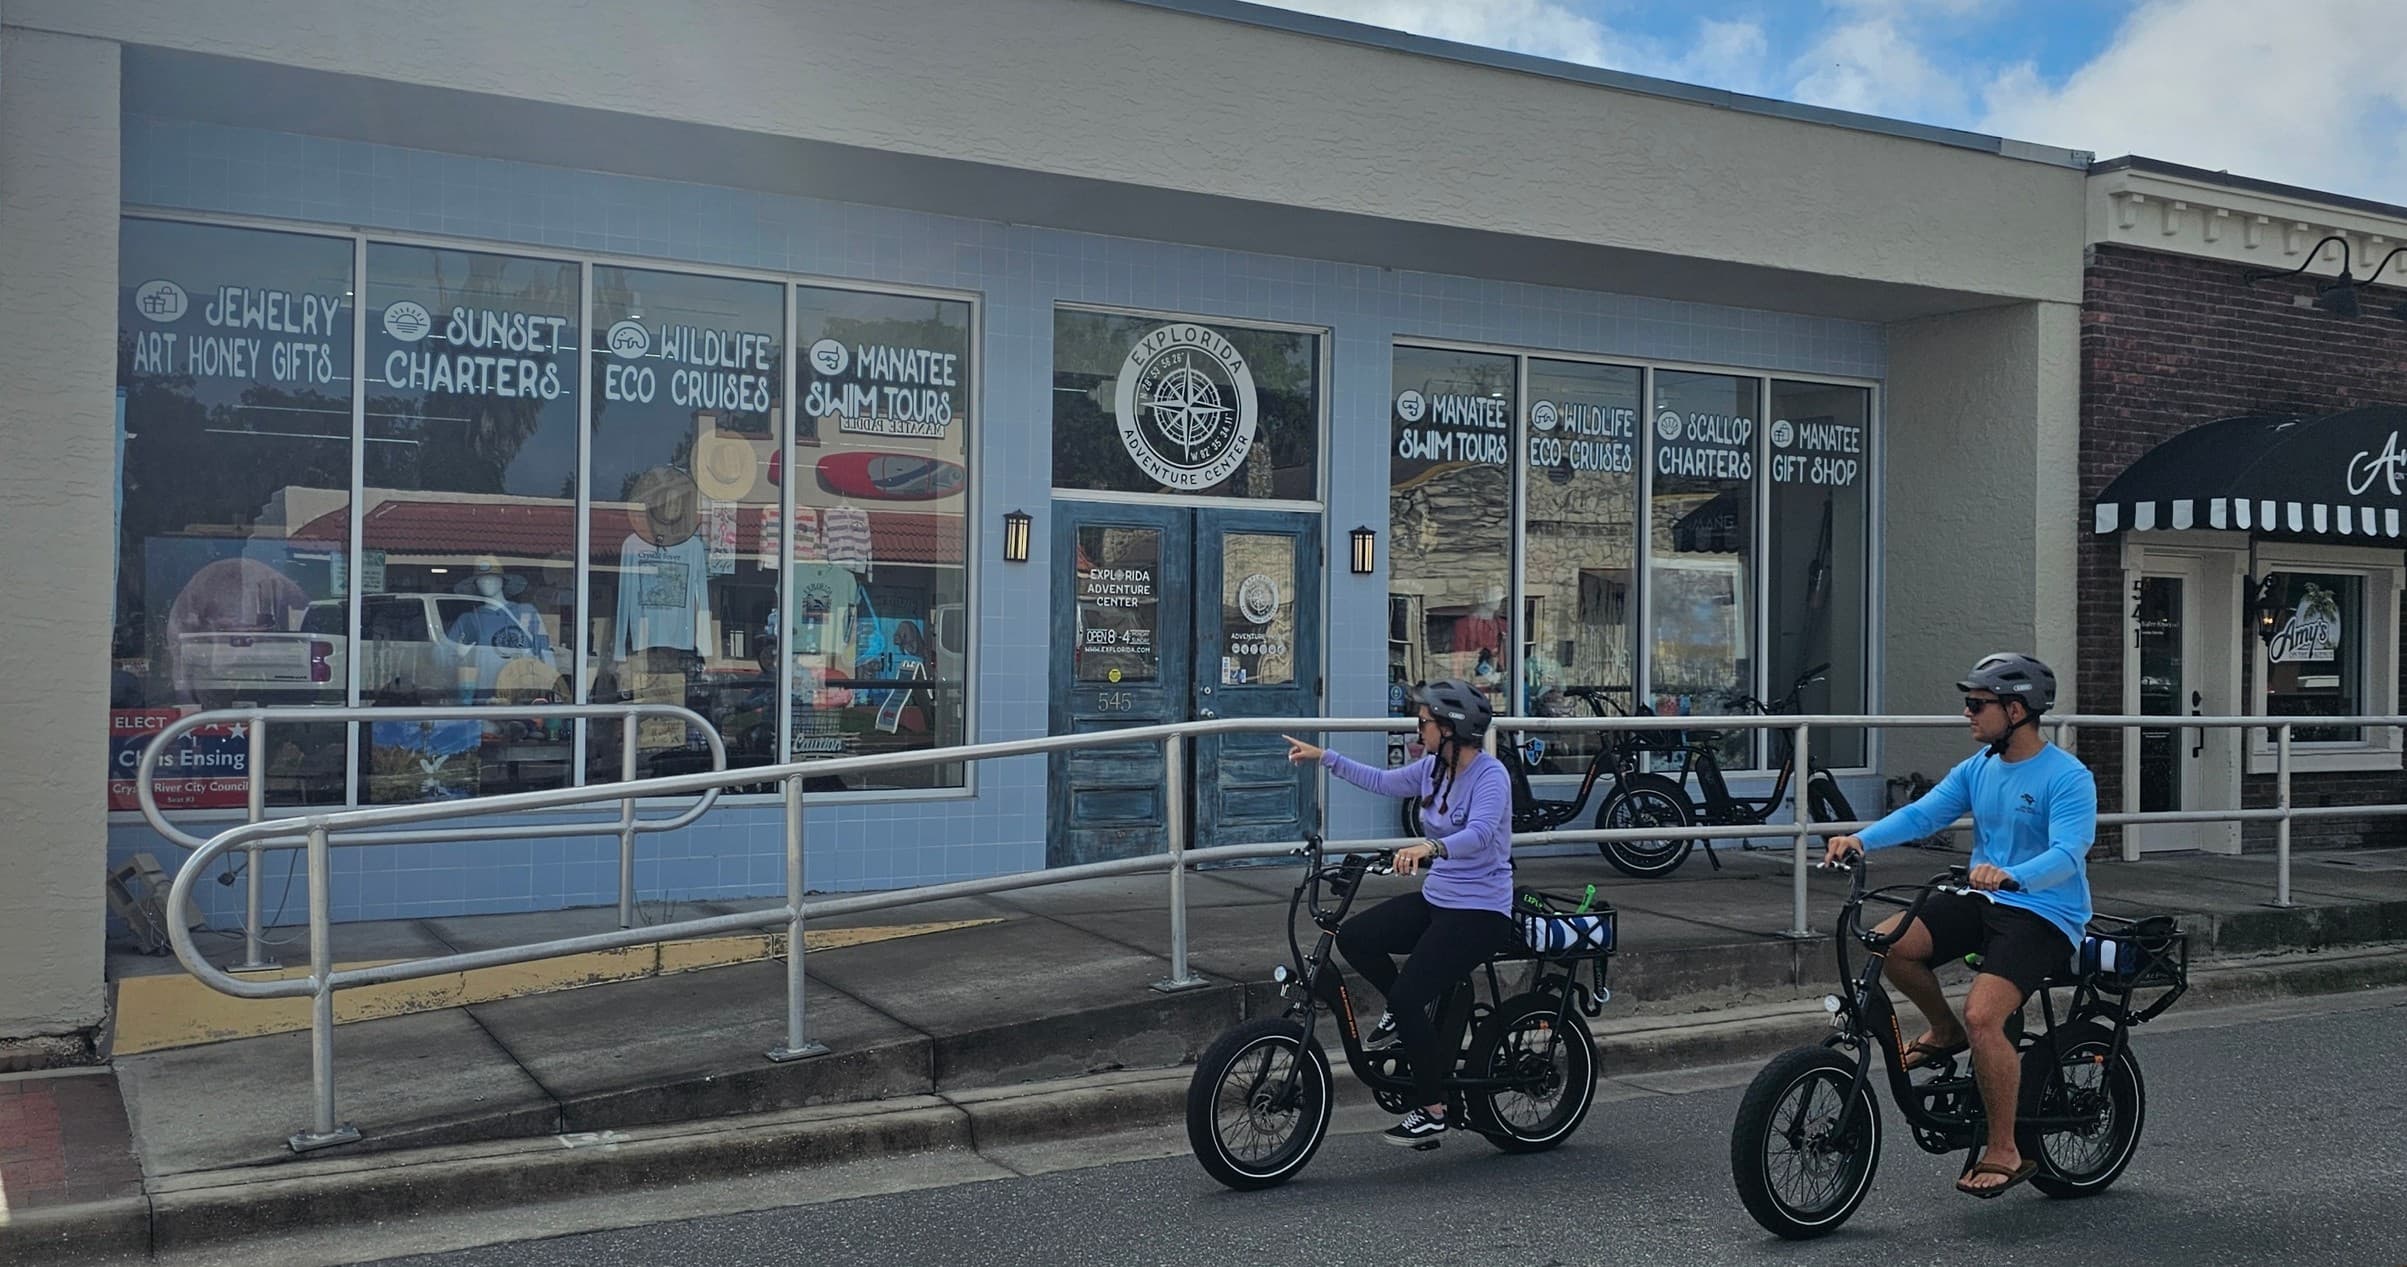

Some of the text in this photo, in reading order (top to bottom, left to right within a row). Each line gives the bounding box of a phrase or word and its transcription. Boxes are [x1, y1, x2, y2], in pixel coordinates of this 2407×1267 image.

[205, 285, 340, 337] JEWELRY
[446, 306, 567, 354] SUNSET
[660, 323, 771, 370] WILDLIFE
[133, 331, 333, 384] ART HONEY GIFTS
[857, 343, 956, 387] MANATEE
[1131, 327, 1243, 374] EXPLORIDA
[385, 350, 561, 400] CHARTERS
[605, 364, 770, 412] ECO CRUISES
[805, 380, 952, 425] SWIM TOURS
[1432, 394, 1507, 429] MANATEE
[1564, 403, 1634, 438] WILDLIFE
[1687, 413, 1752, 446] SCALLOP
[1399, 428, 1508, 465] SWIM TOURS
[1530, 437, 1632, 473] ECO CRUISES
[1799, 425, 1861, 454] MANATEE
[1123, 430, 1249, 485] ADVENTURE CENTER
[1658, 448, 1752, 481] CHARTERS
[1773, 453, 1857, 487] GIFT SHOP
[1087, 584, 1151, 595] ADVENTURE
[1096, 596, 1138, 607] CENTER
[1086, 630, 1107, 642] OPEN
[2269, 616, 2329, 662] Amy's
[1098, 691, 1132, 711] 545
[115, 716, 167, 729] ELECT
[119, 748, 245, 770] Chis Ensing
[154, 783, 182, 793] River
[185, 782, 206, 794] City
[209, 781, 248, 791] Council
